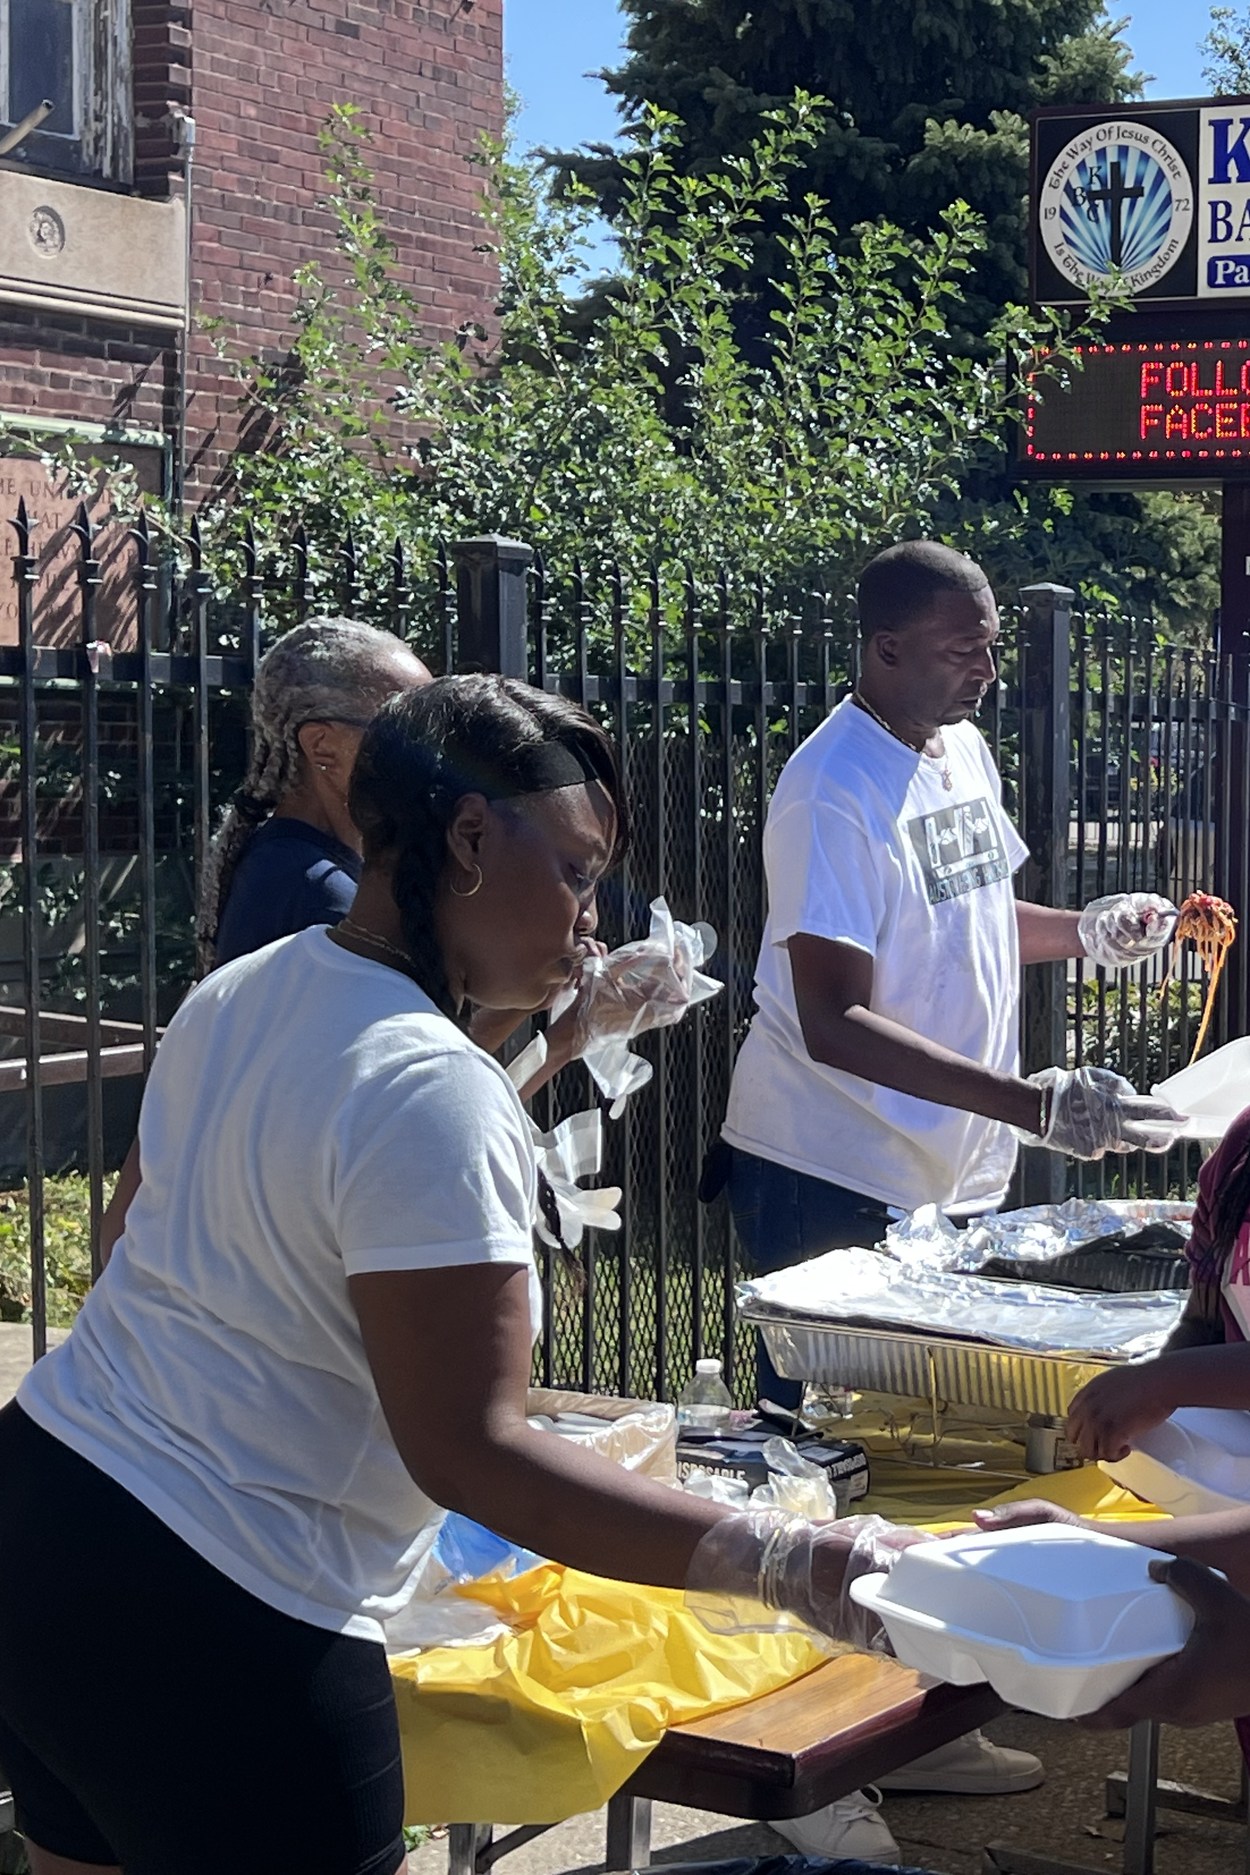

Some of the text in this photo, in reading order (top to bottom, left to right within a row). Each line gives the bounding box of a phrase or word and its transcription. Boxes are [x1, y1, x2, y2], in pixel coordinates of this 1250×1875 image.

[1048, 125, 1182, 190] The Way Of Jesus Christ
[1044, 207, 1057, 220] 19
[1174, 199, 1191, 212] 72
[1053, 241, 1066, 257] Is
[1130, 237, 1179, 288] Kingdom
